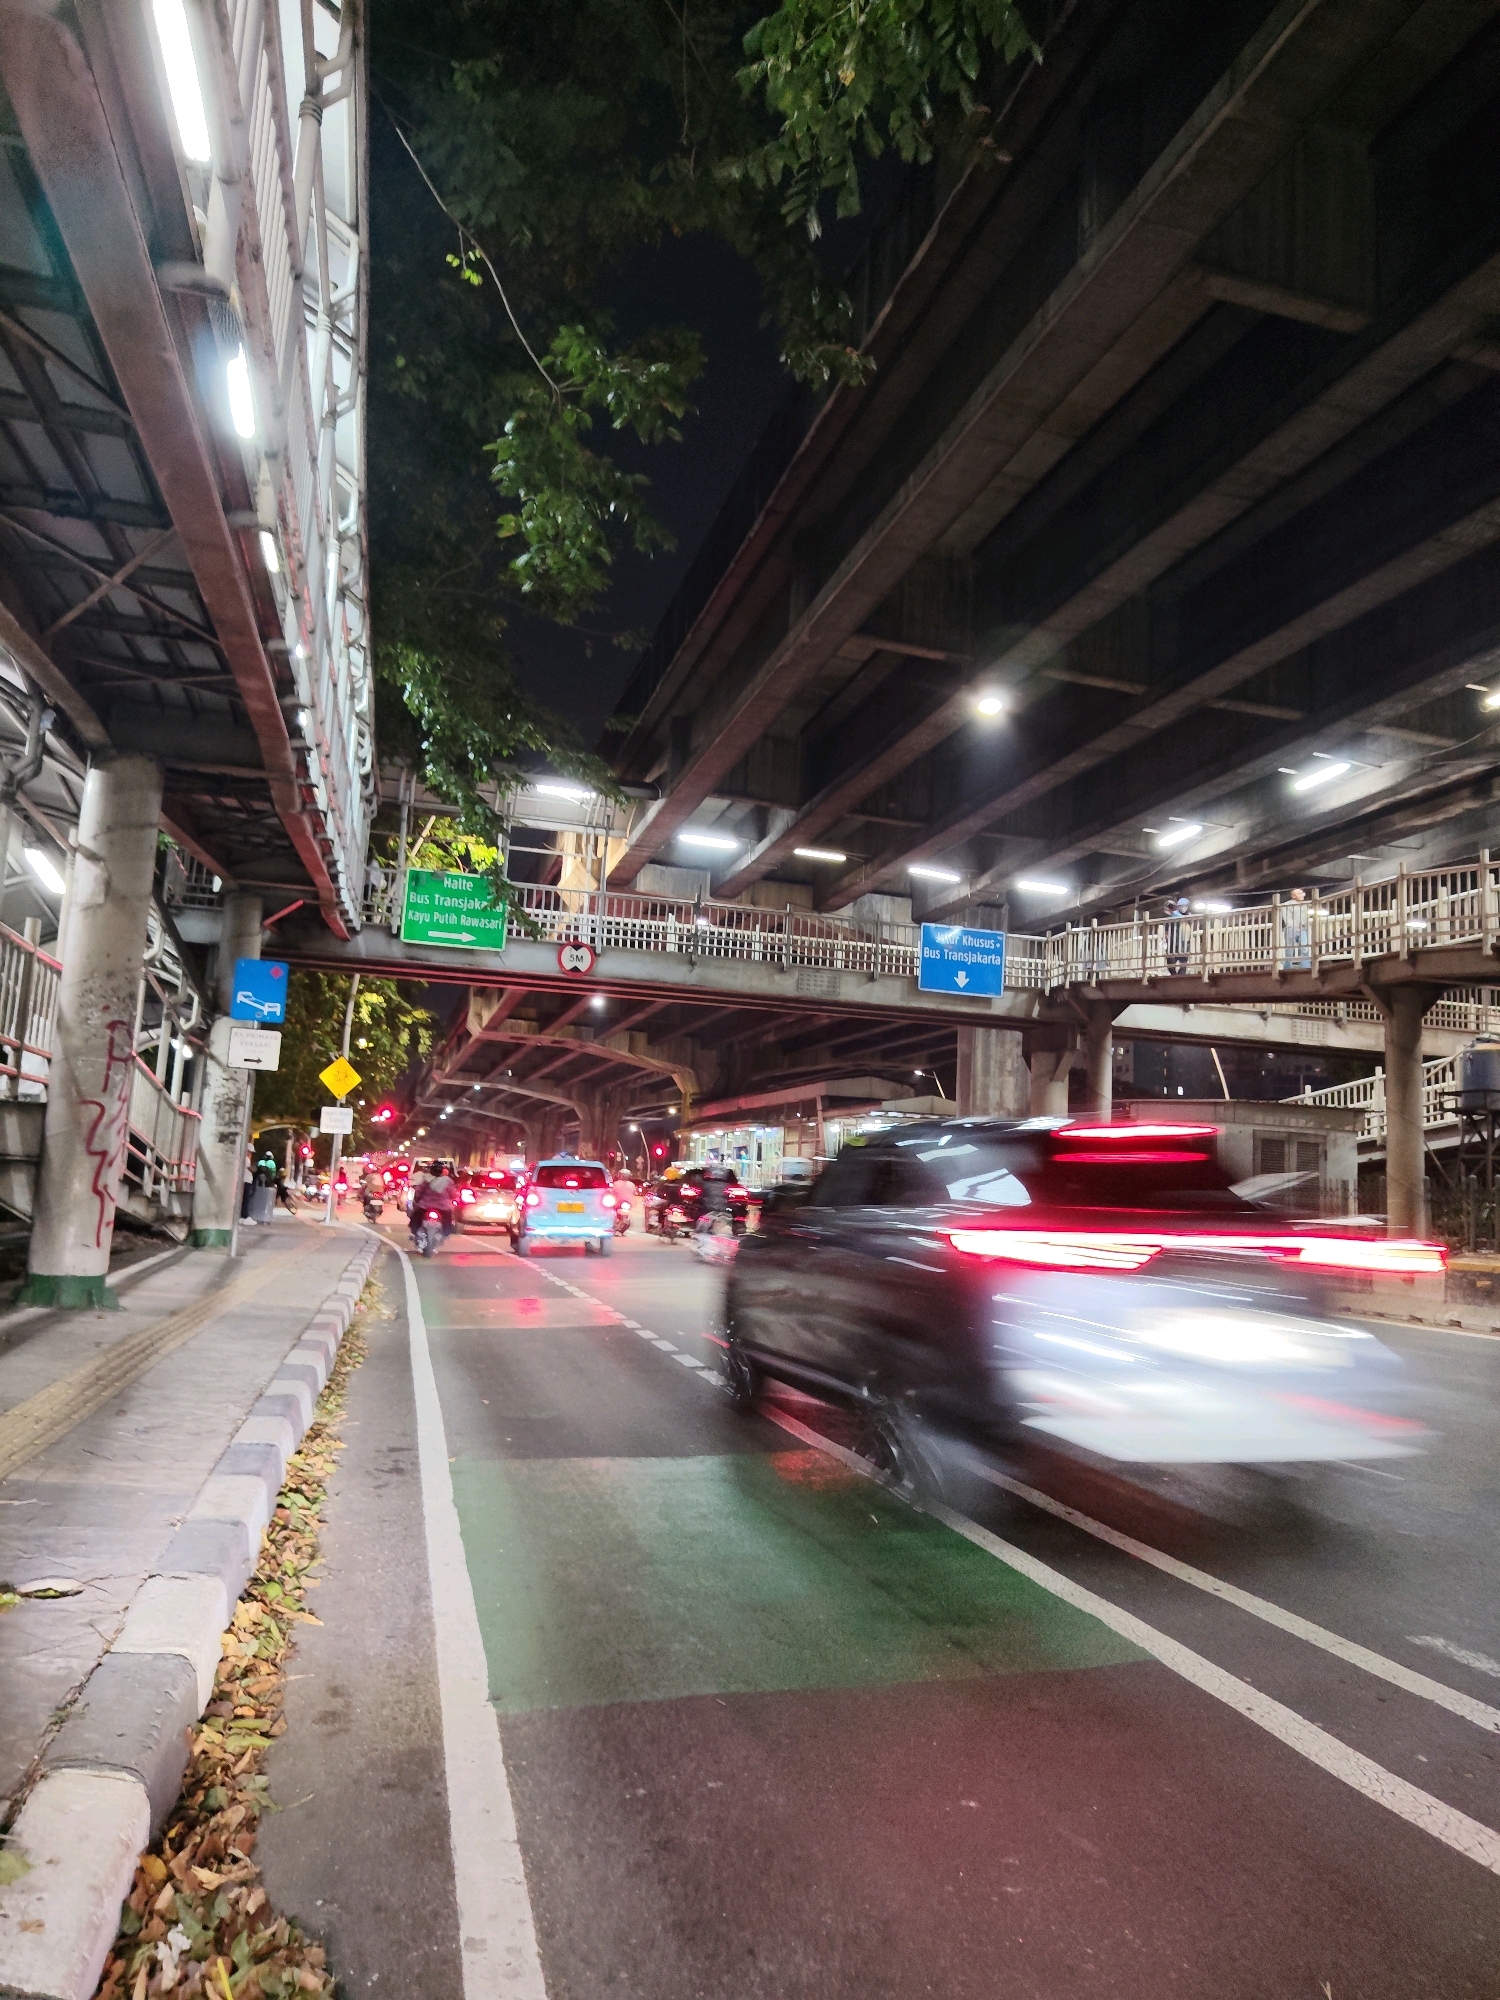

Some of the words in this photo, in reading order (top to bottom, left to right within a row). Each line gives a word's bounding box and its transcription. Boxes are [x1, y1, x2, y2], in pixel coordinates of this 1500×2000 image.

[443, 876, 474, 892] Halte
[409, 891, 430, 905] Bus
[434, 893, 504, 913] Transjakaa
[407, 910, 431, 925] Kayu
[433, 911, 458, 925] Putih
[460, 914, 503, 930] Rawasari
[962, 934, 995, 949] Khusus
[923, 946, 941, 960] Bus
[943, 948, 1001, 966] Transjakarta
